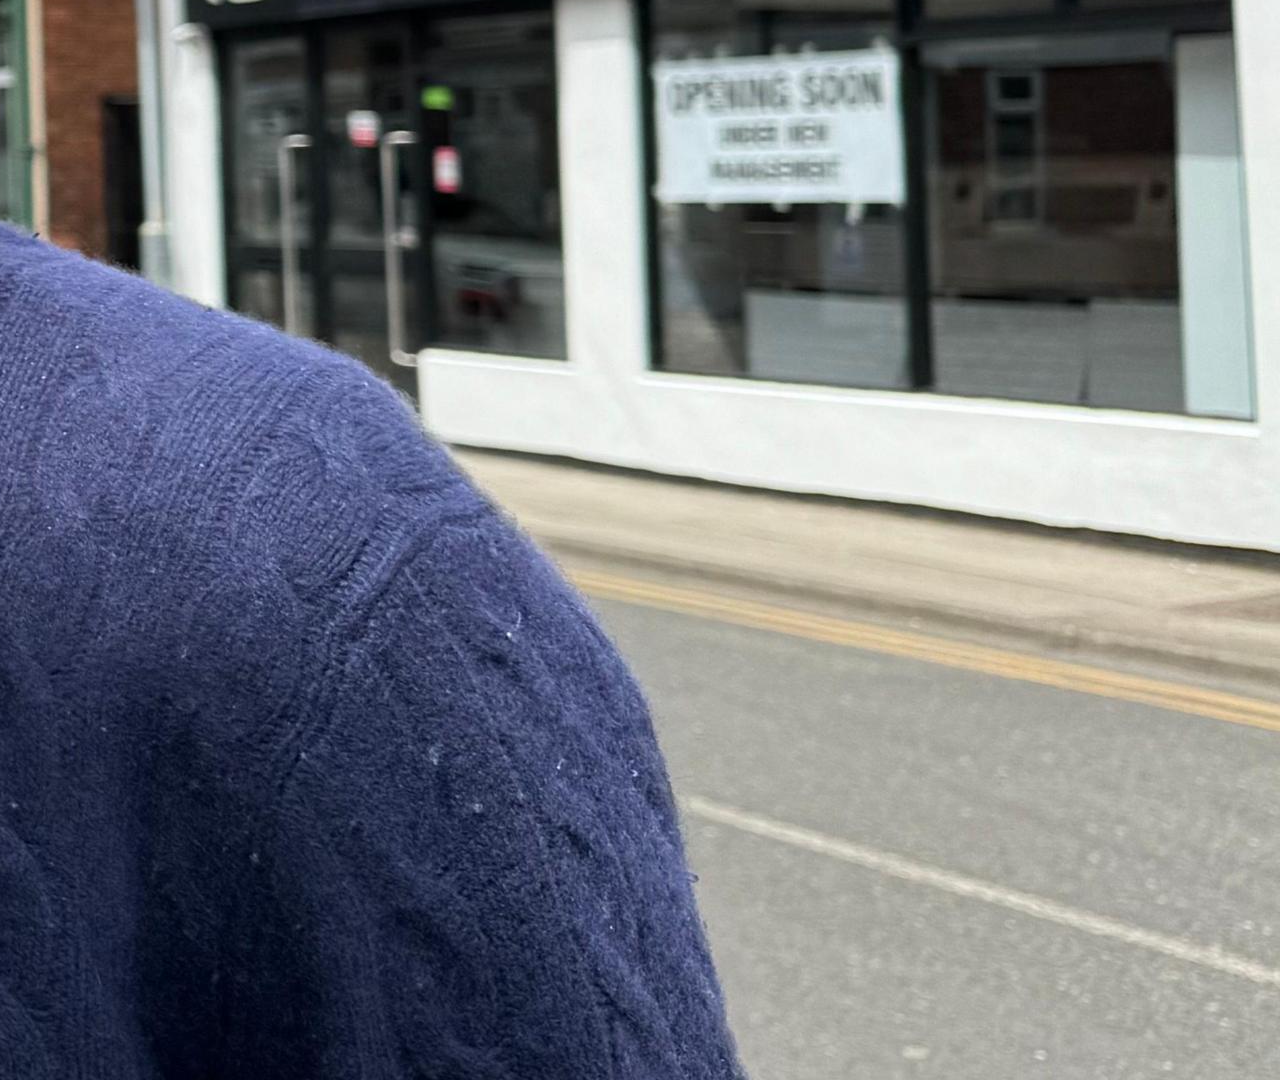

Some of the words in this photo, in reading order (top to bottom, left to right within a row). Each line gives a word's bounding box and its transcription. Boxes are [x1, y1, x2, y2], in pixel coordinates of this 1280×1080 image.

[670, 73, 793, 114] OPENING
[797, 67, 886, 111] SOON
[718, 124, 779, 147] UNDER
[786, 122, 831, 146] NEW
